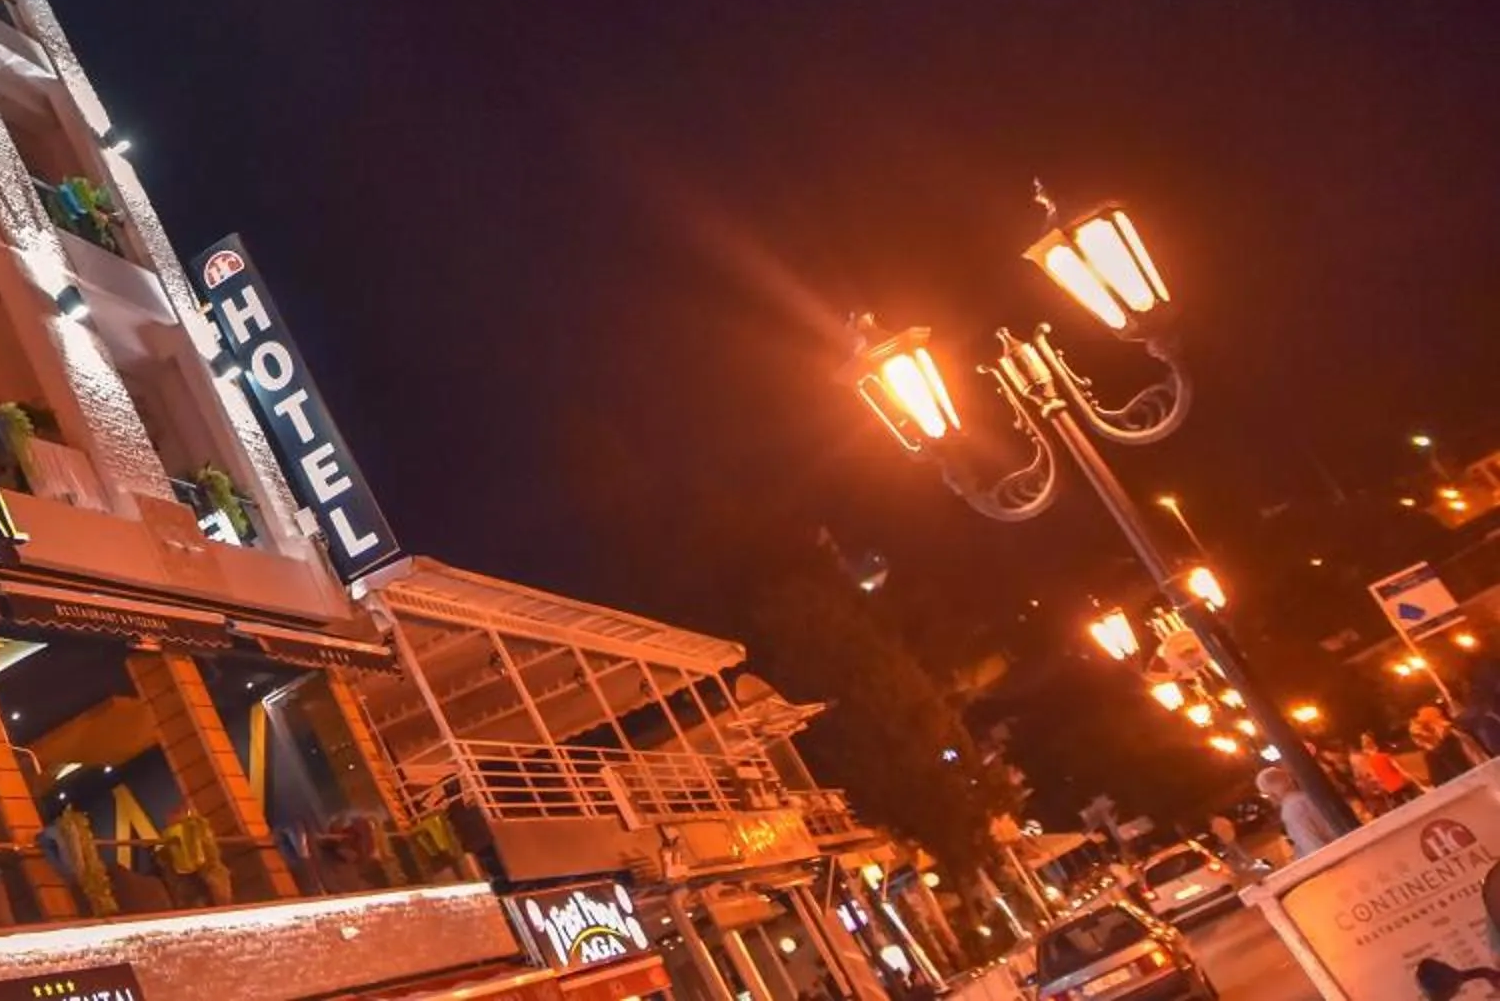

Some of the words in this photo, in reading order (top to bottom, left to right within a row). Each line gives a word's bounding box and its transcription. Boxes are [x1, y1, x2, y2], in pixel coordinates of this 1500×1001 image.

[221, 285, 379, 558] HOTEL
[1334, 844, 1500, 931] CONTINENTAL
[581, 935, 627, 964] AGA
